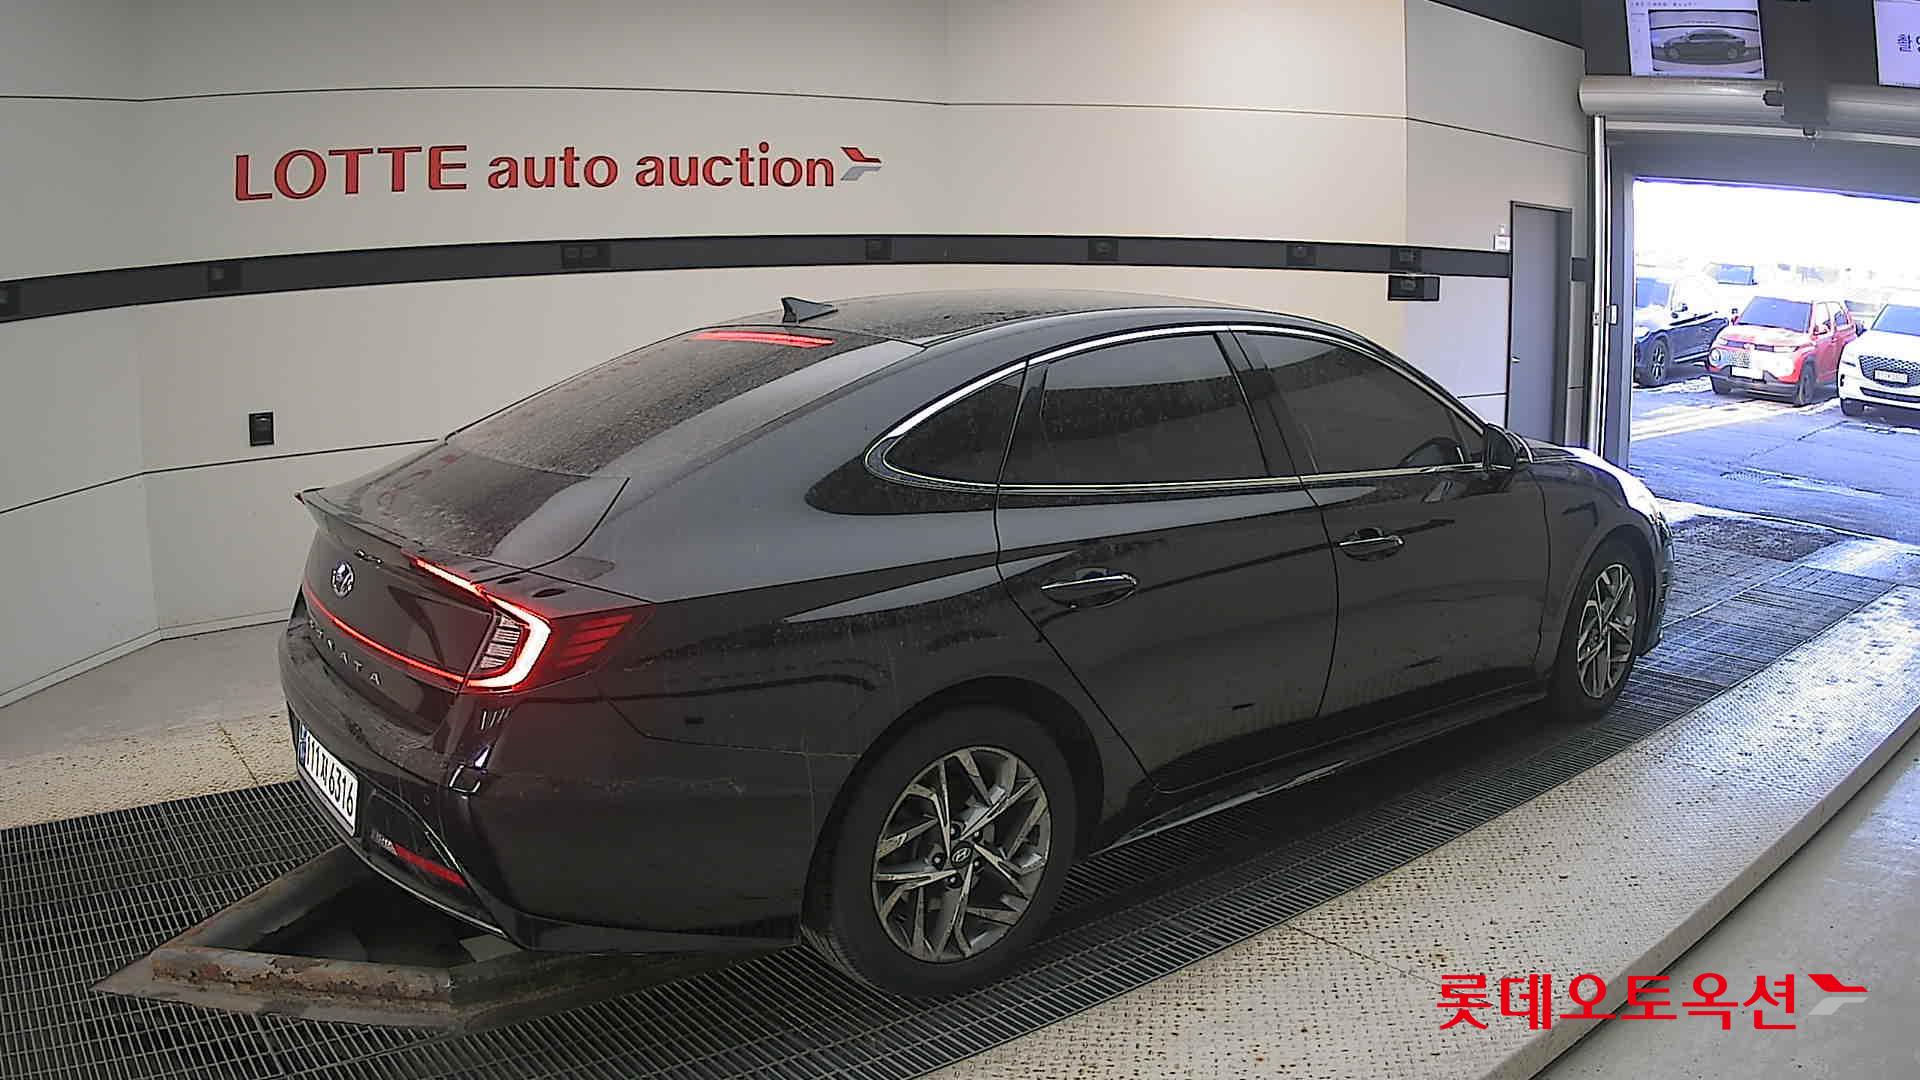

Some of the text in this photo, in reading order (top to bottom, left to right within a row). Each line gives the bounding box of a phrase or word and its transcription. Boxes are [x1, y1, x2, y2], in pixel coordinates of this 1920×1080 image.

[235, 141, 834, 201] LOTTE auto auction
